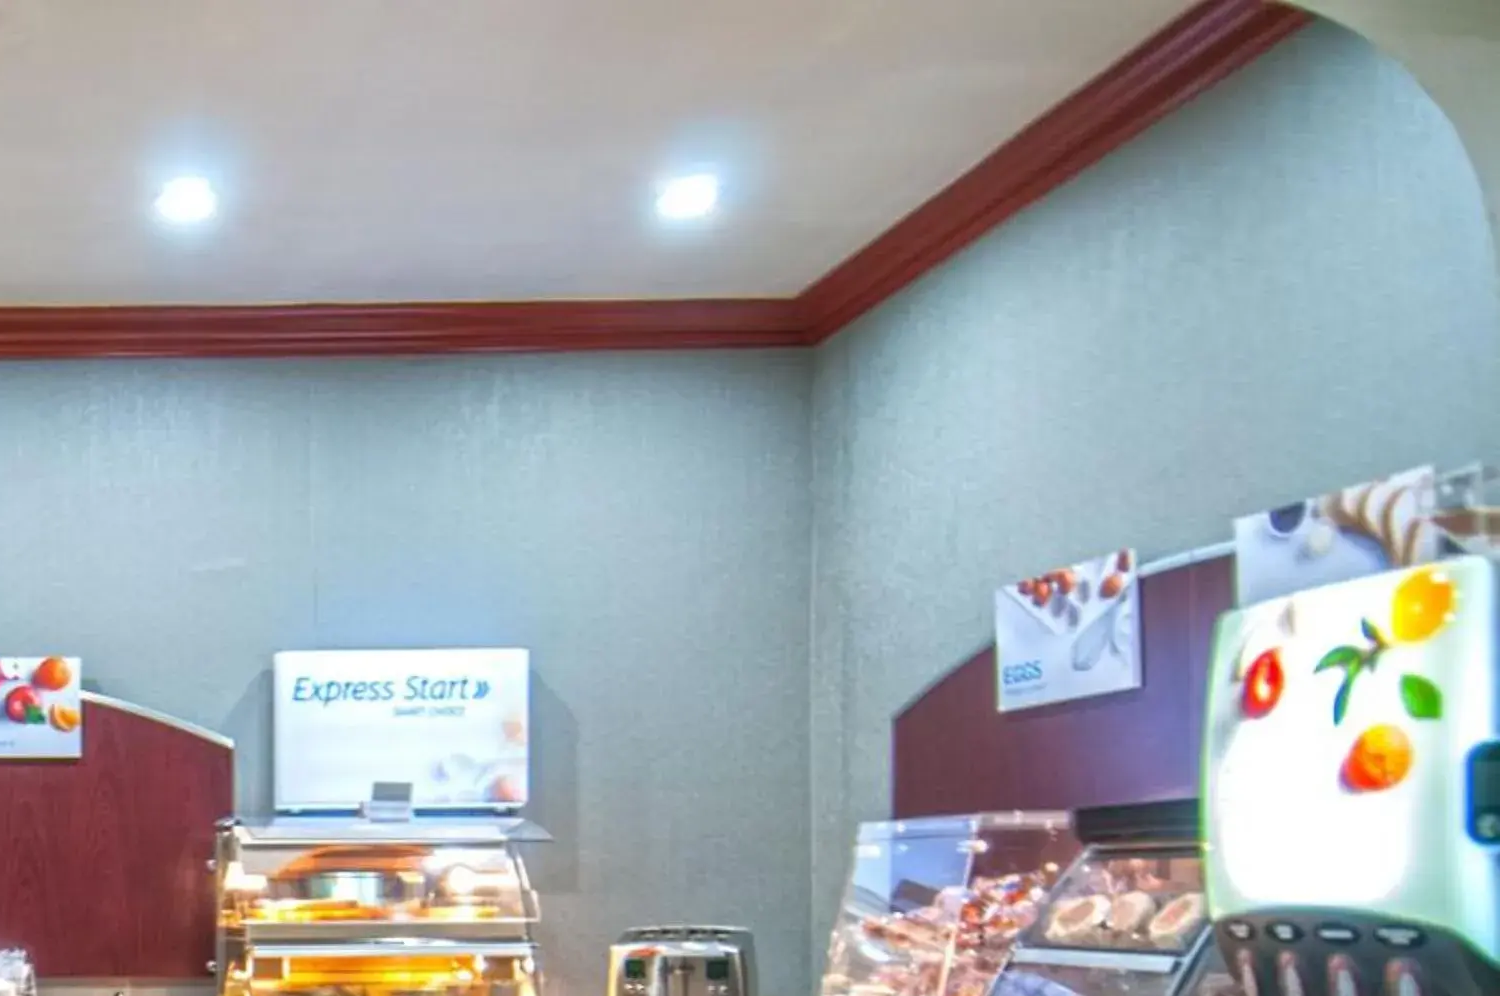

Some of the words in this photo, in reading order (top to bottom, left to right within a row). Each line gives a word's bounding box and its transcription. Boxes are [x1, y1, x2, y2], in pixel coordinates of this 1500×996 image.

[1003, 660, 1043, 685] EGGS
[291, 677, 394, 706] Express
[404, 675, 469, 701] Start
